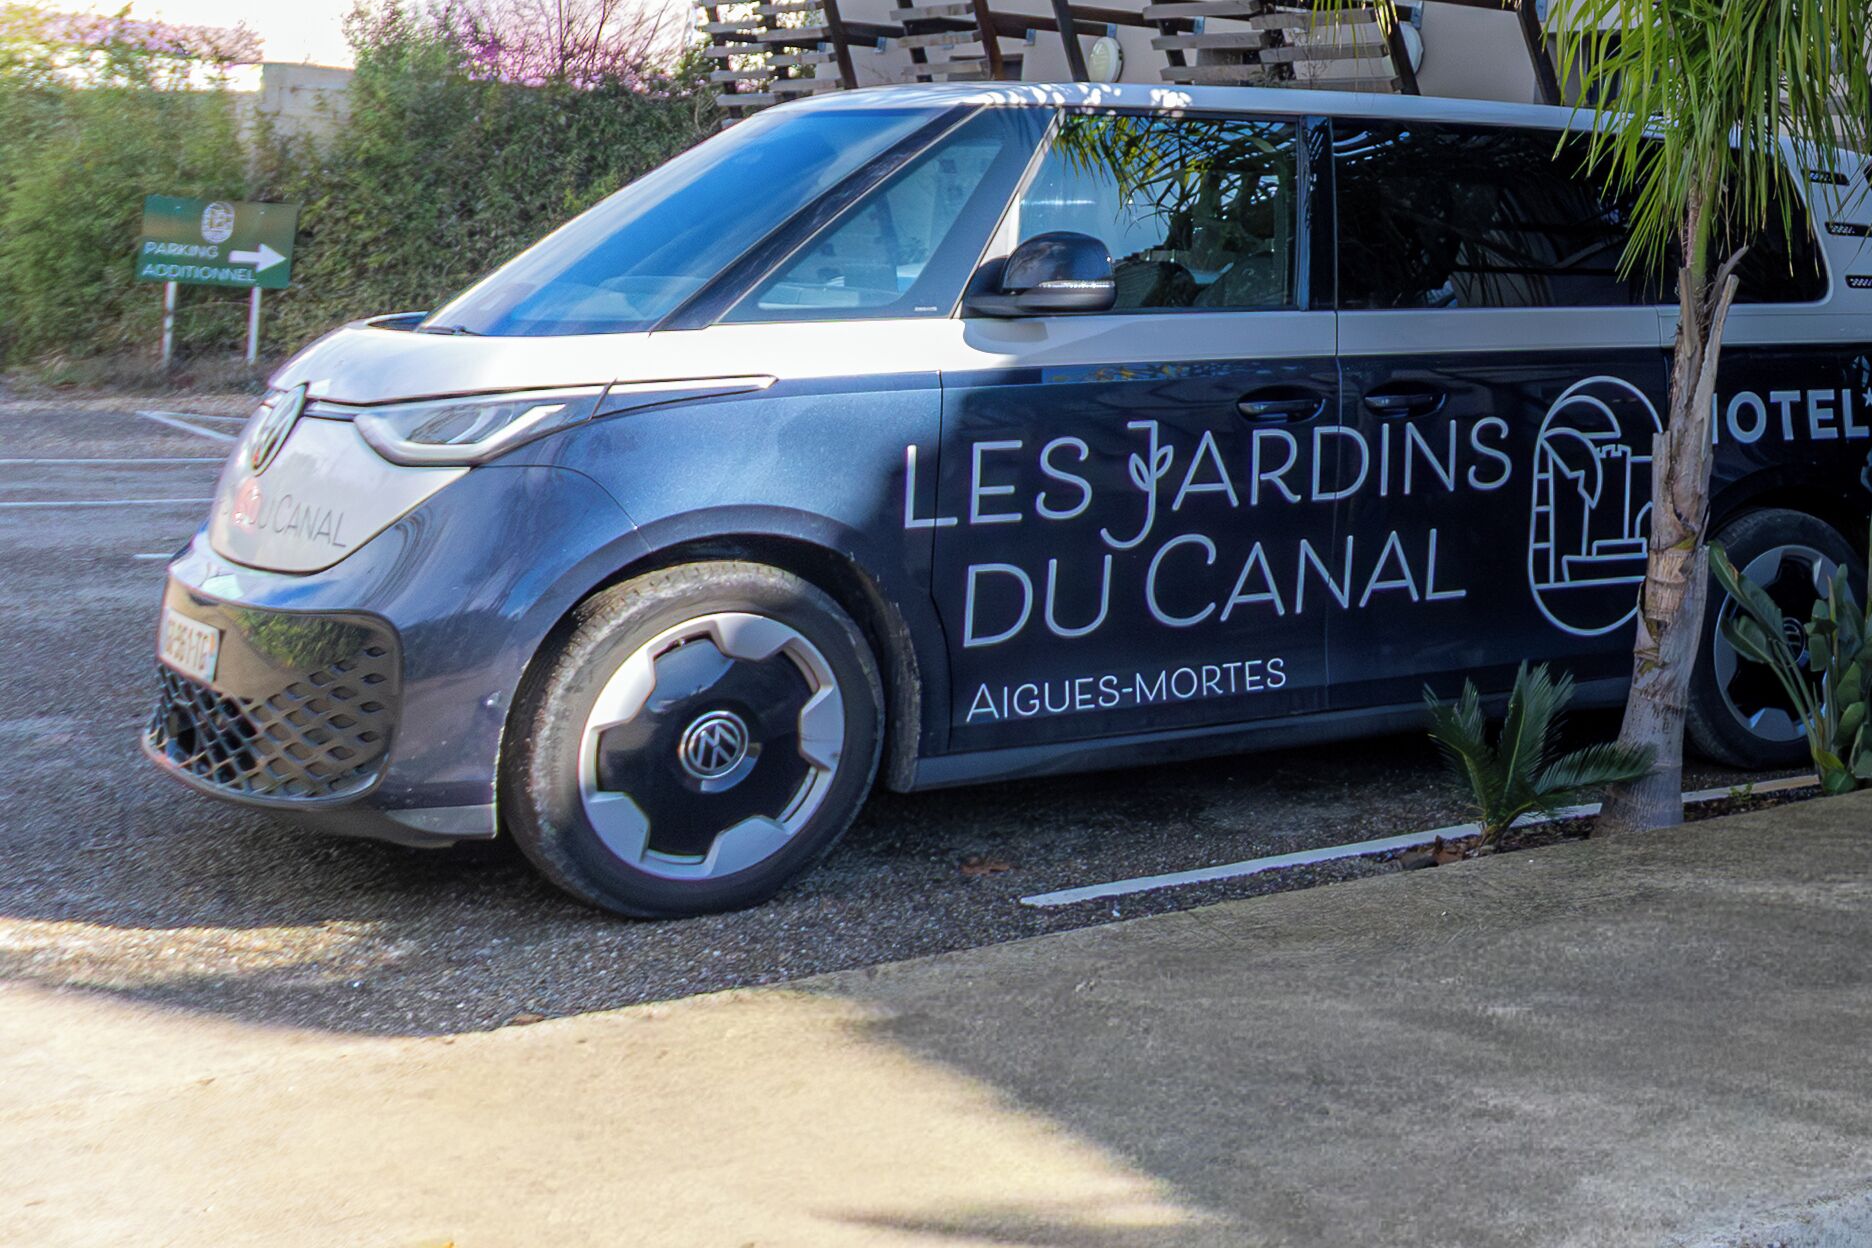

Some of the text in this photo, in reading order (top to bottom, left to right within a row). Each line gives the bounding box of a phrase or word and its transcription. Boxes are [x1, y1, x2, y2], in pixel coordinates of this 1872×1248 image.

[142, 263, 257, 282] ADDITIONNEL
[143, 241, 219, 259] PARKING
[903, 415, 1514, 549] LES JARDINS
[271, 493, 347, 548] CANAL
[962, 528, 1467, 649] DU CANAL
[965, 657, 1287, 724] AIGUES-MORTES
